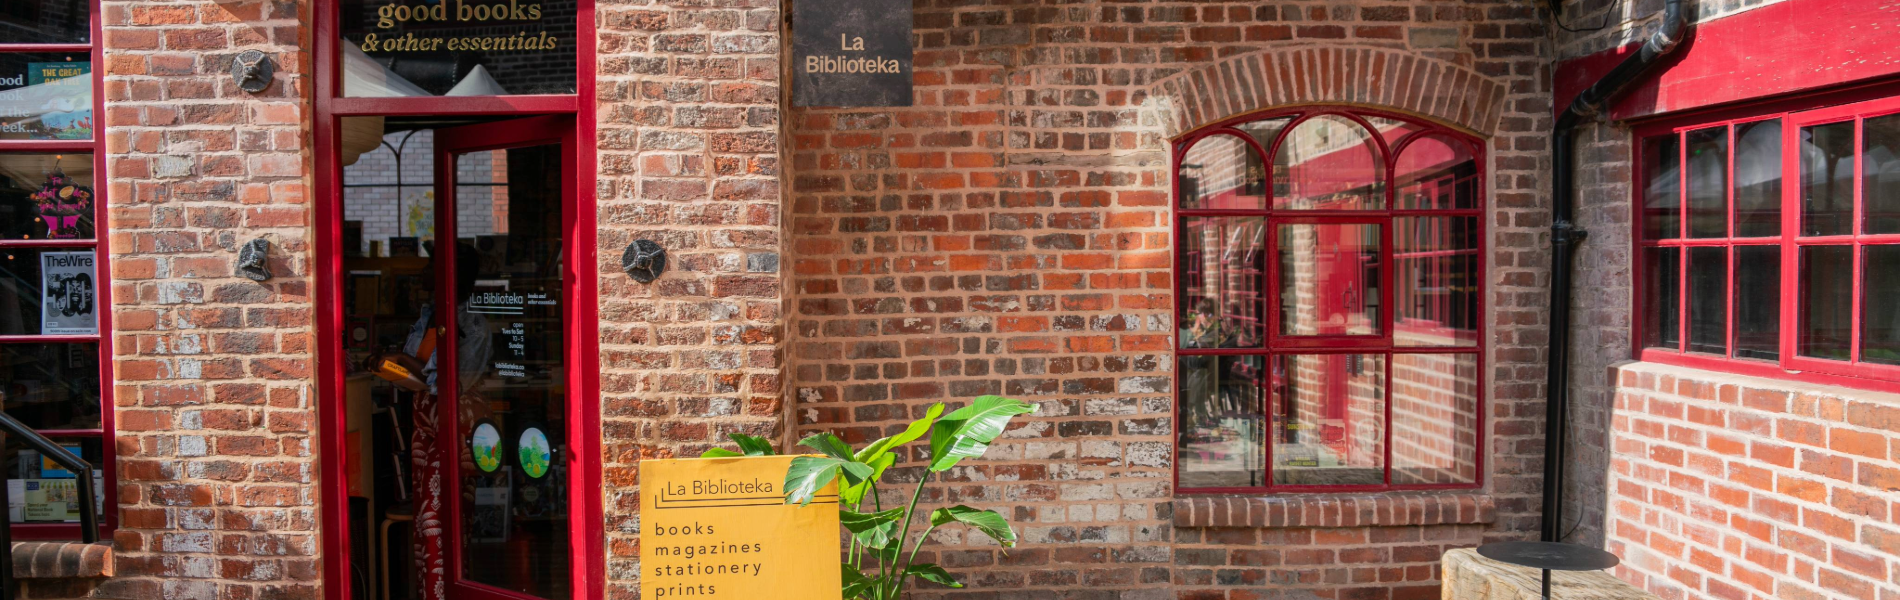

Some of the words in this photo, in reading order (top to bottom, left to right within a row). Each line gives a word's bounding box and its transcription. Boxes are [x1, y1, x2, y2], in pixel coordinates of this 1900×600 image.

[377, 0, 447, 28] good
[456, 0, 541, 21] books
[361, 33, 378, 51] &
[383, 33, 442, 51] other
[447, 31, 557, 50] essentials
[841, 33, 864, 51] La
[806, 55, 900, 73] Biblioteka
[0, 74, 24, 86] ood
[42, 69, 56, 77] THE
[58, 68, 82, 77] GREAT
[0, 89, 23, 101] ook
[8, 105, 30, 118] the
[472, 292, 482, 304] La
[483, 292, 523, 304] Biblioteka
[509, 342, 524, 350] Sunday
[668, 481, 686, 496] La
[693, 478, 773, 495] Biblioteka
[655, 521, 714, 536] books
[655, 541, 761, 559] magazines
[655, 562, 762, 577] stationery
[655, 583, 715, 600] prints
